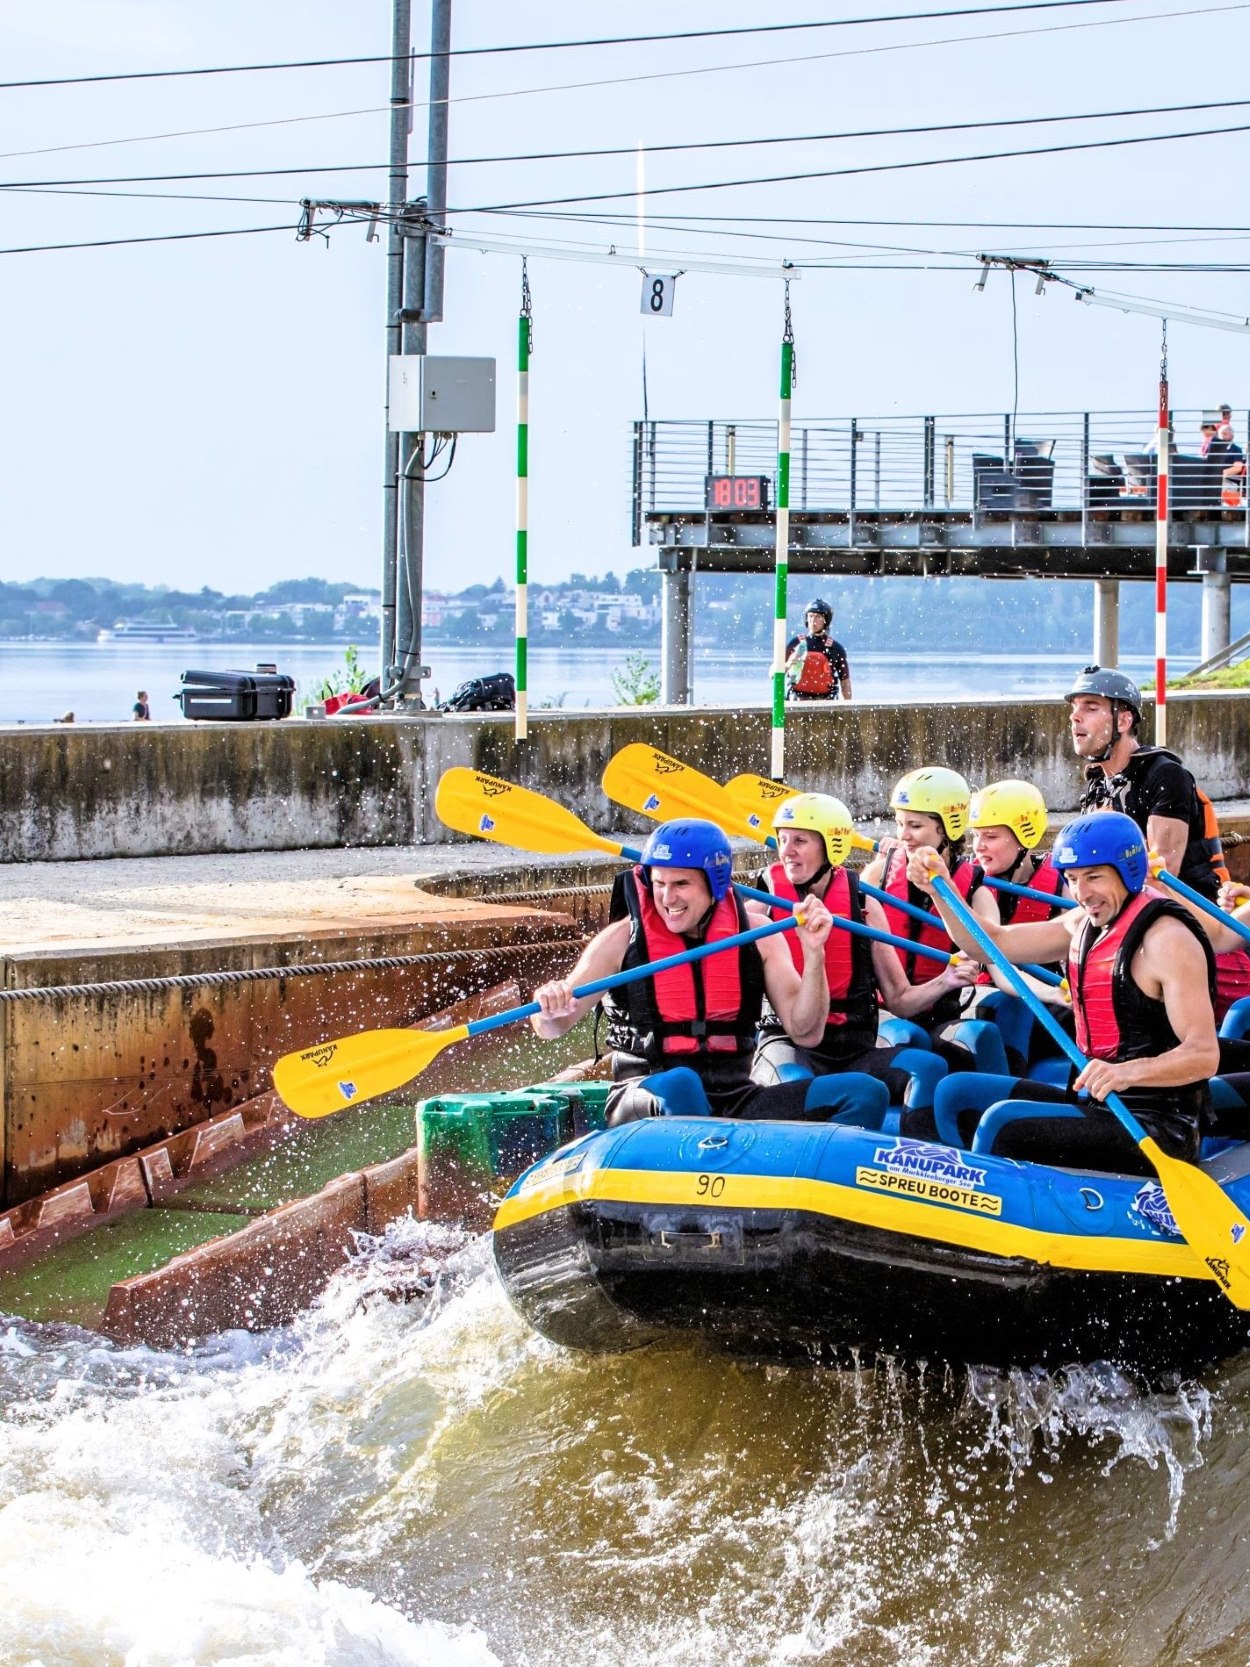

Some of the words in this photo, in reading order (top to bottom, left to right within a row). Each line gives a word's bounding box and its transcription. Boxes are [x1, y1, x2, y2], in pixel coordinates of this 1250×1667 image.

[650, 279, 664, 312] 8
[475, 775, 512, 792] KANUPARK
[300, 1043, 338, 1061] KANUPARK
[877, 1150, 985, 1183] KANUPARK
[696, 1174, 726, 1198] 90
[879, 1174, 927, 1195] SPREU
[929, 1186, 980, 1207] BOOTE
[958, 1180, 972, 1188] See
[1204, 1256, 1231, 1290] KANUPARK
